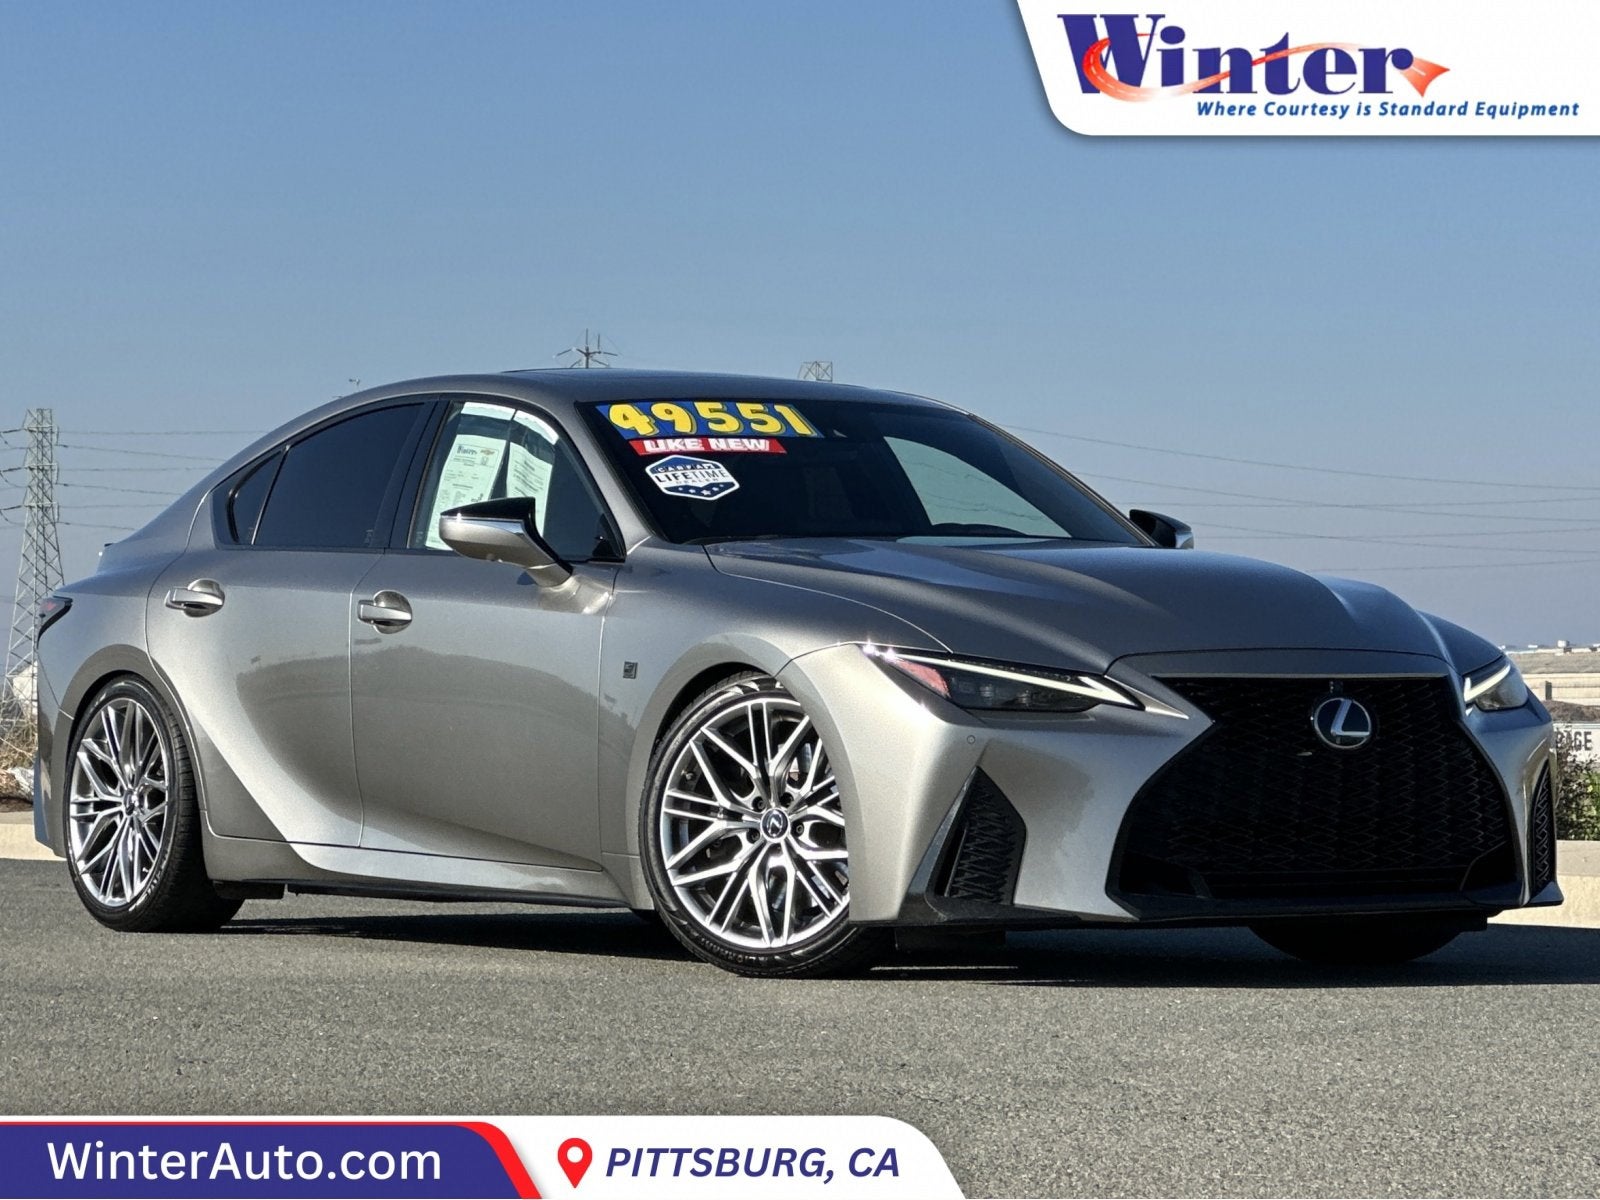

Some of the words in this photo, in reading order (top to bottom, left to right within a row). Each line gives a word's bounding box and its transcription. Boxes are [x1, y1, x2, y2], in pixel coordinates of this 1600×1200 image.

[608, 402, 817, 436] 49551
[643, 438, 704, 452] LIKE
[708, 438, 771, 451] NEW
[655, 469, 728, 483] LIFETIME
